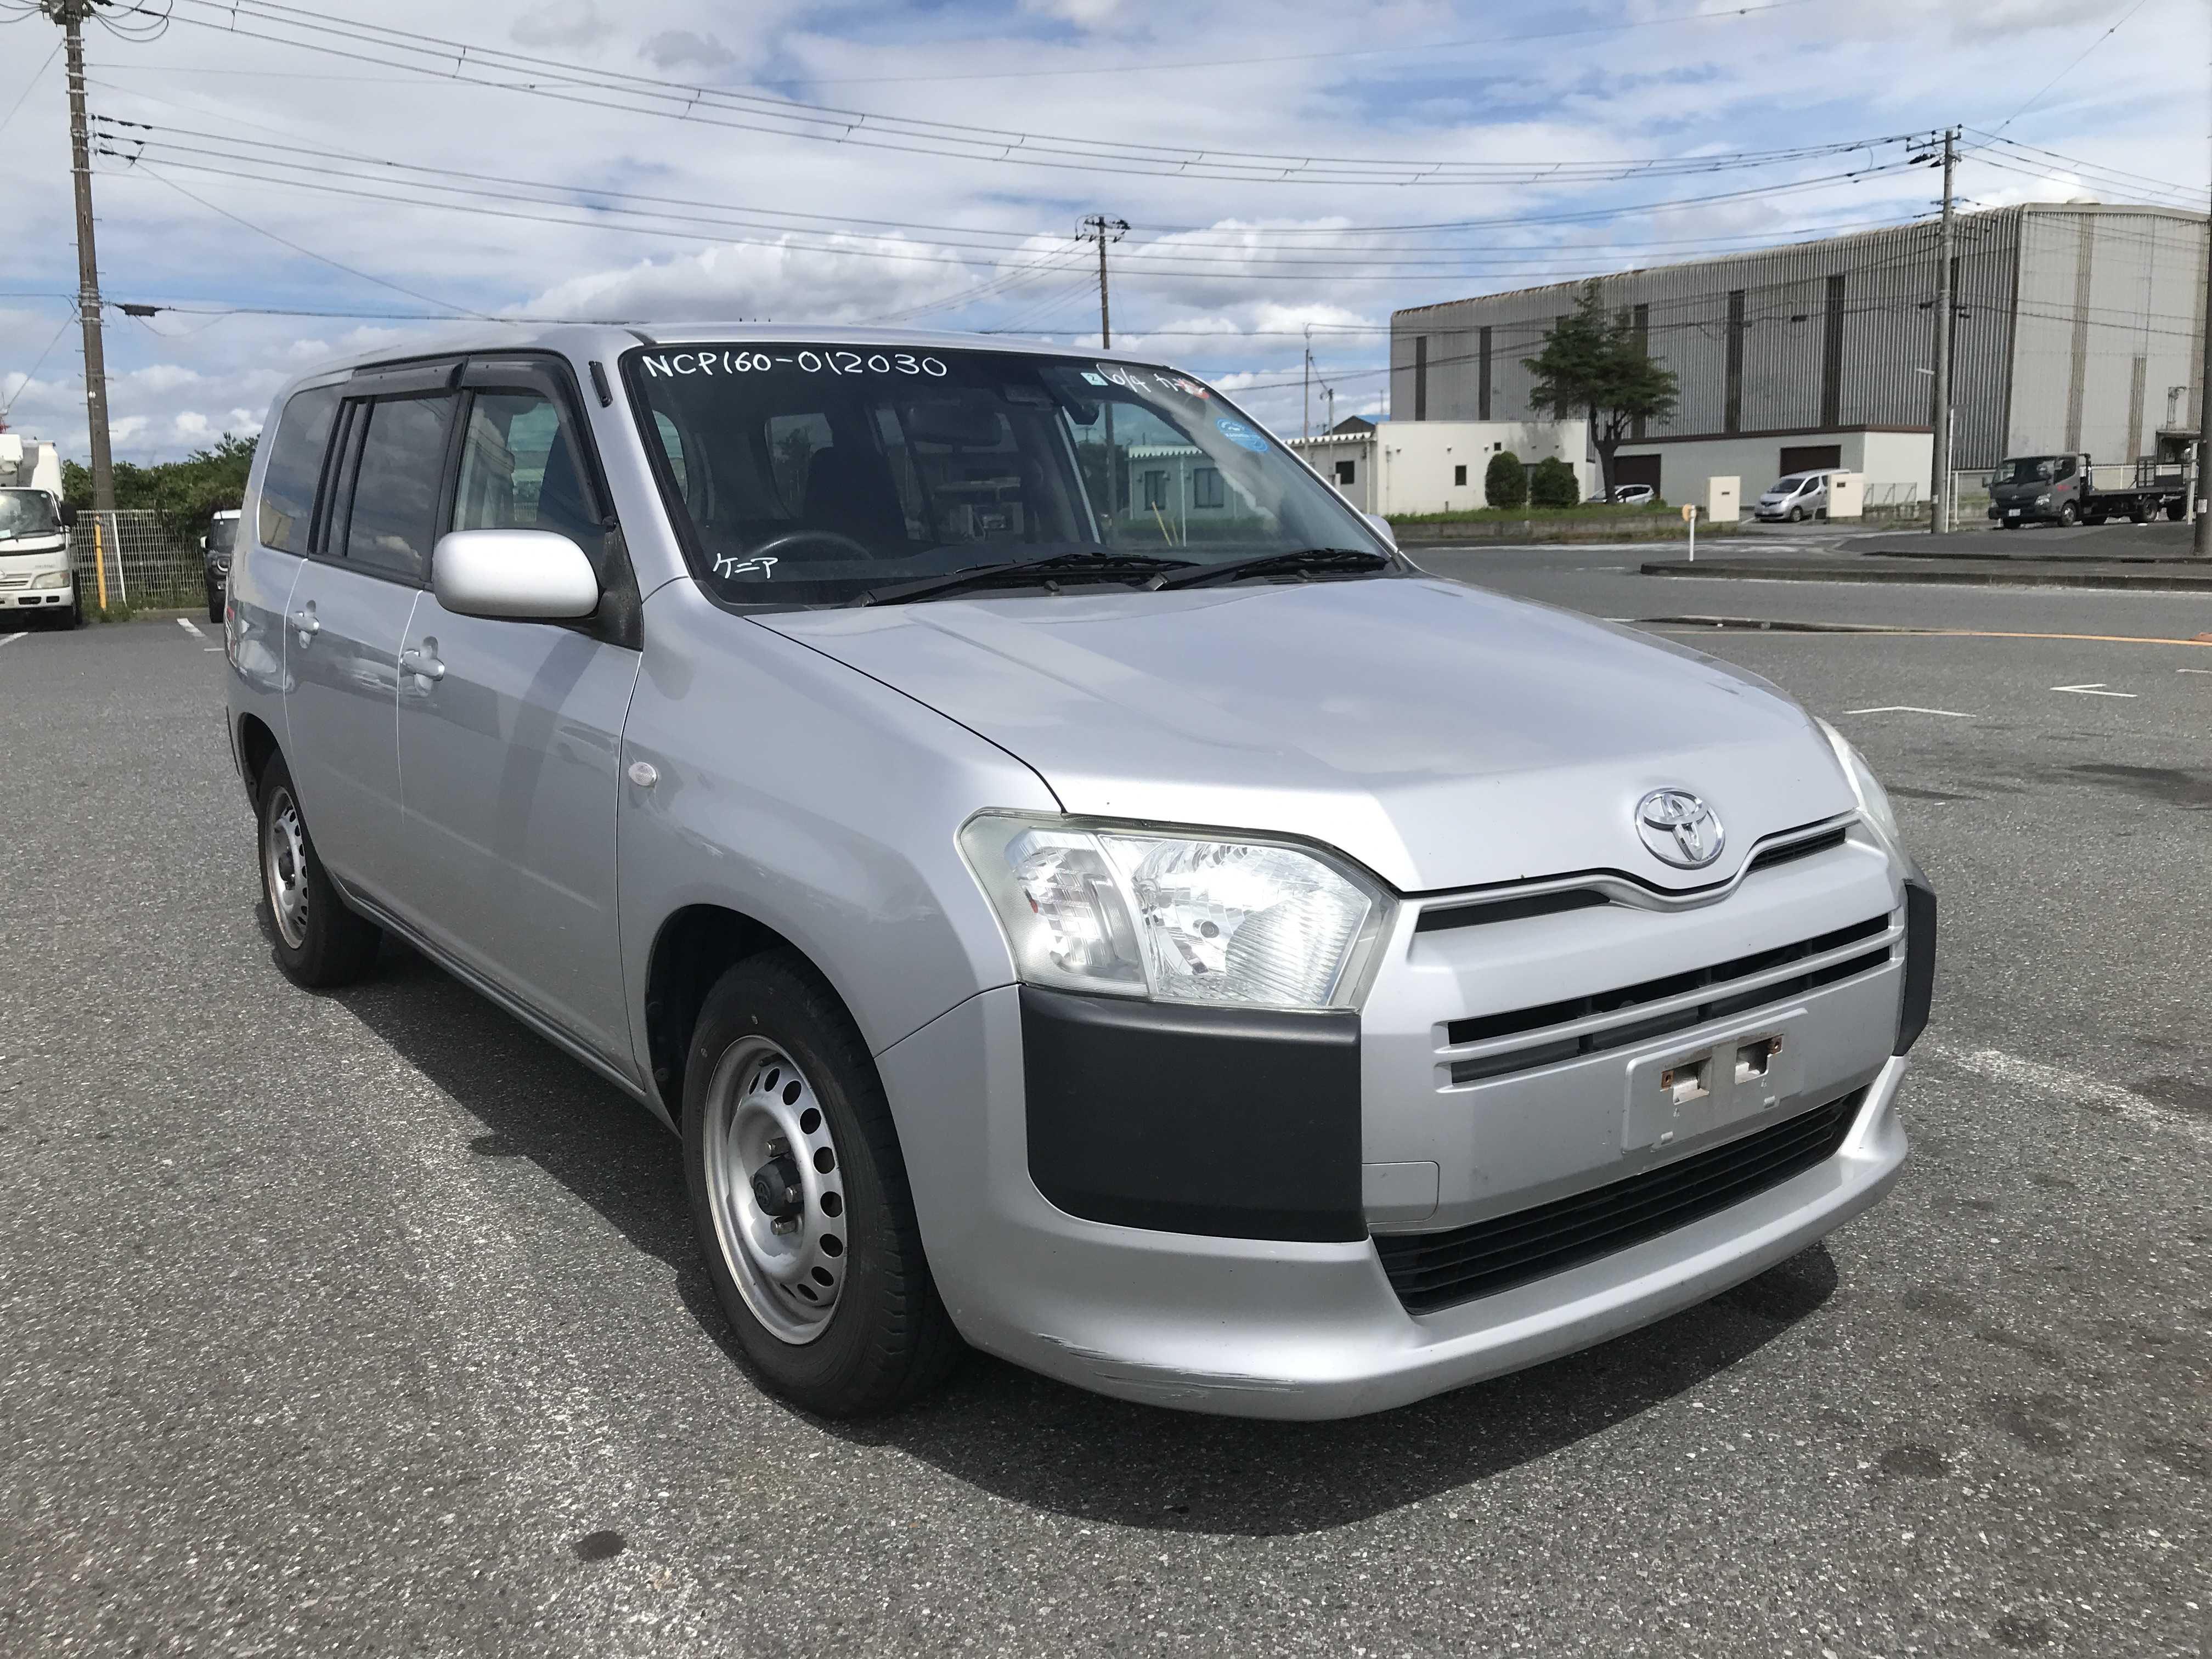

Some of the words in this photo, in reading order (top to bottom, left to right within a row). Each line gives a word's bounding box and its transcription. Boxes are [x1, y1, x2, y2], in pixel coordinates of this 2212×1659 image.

[642, 351, 947, 377] NCP160-012030
[712, 552, 778, 579] ケニア
